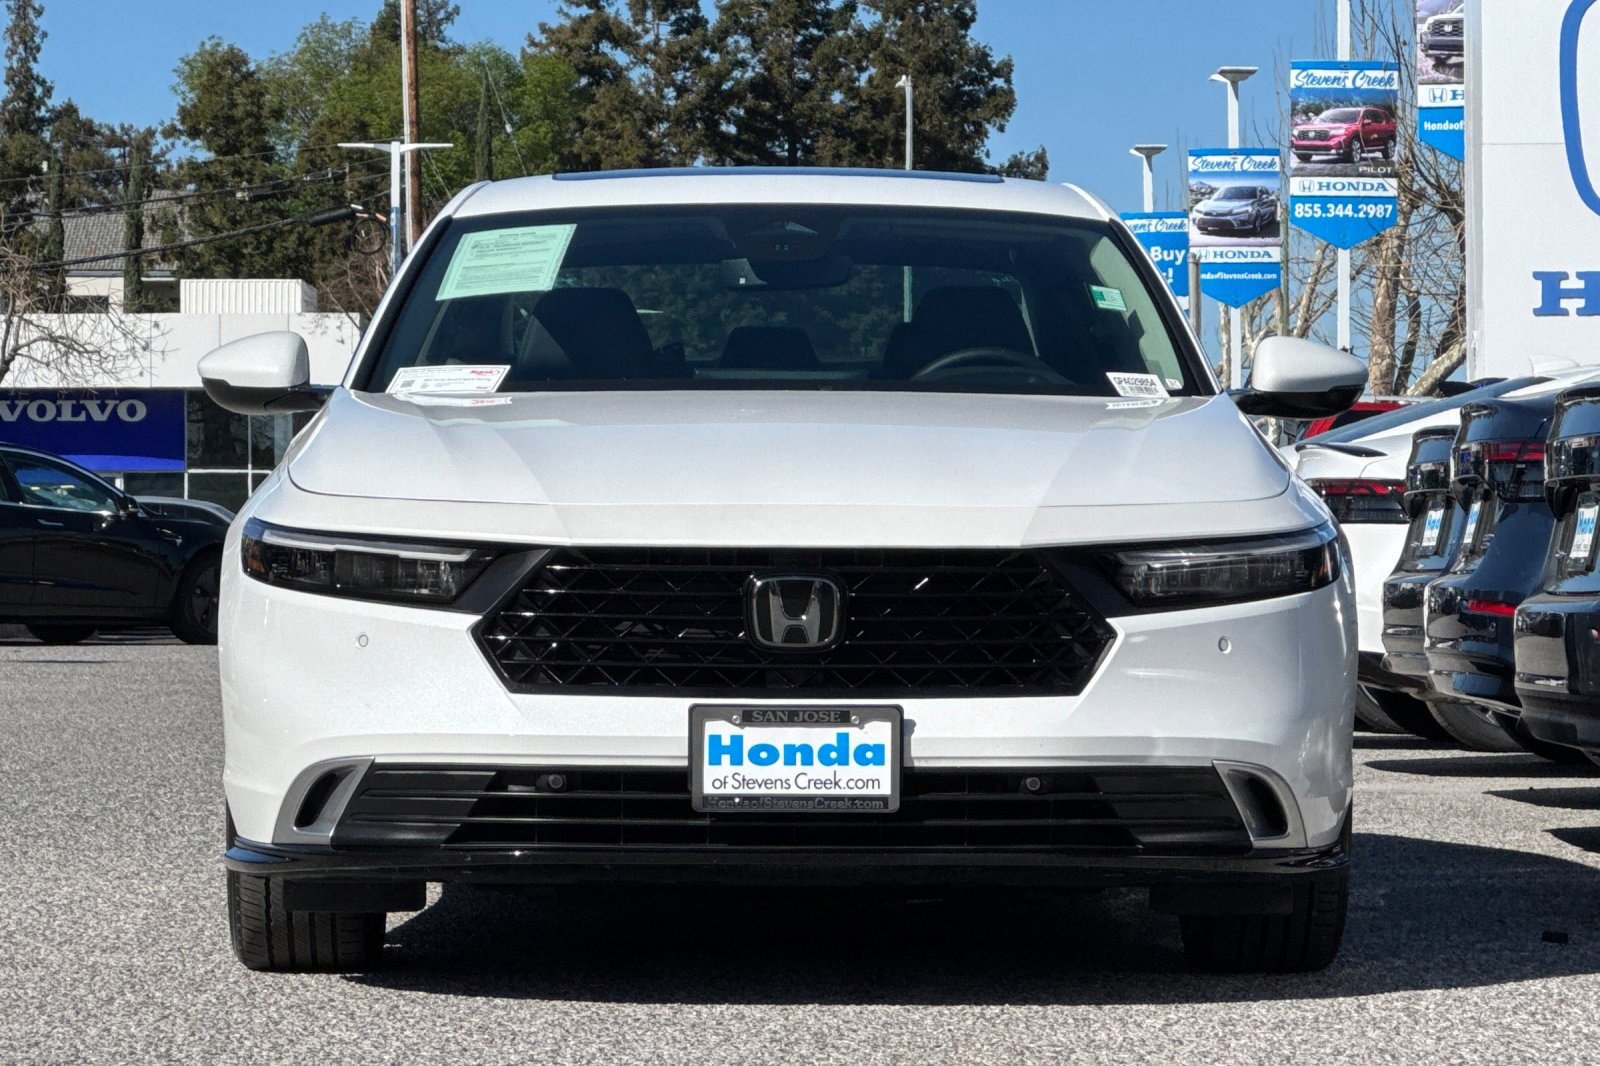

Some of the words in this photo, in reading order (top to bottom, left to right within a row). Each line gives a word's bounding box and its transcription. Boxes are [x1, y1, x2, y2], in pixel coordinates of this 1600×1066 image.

[1294, 70, 1350, 88] Stevens
[1352, 69, 1396, 89] Creek
[1191, 156, 1237, 171] Stevens
[1240, 156, 1277, 172] Creek
[1358, 166, 1393, 174] PILOT
[1317, 181, 1389, 192] HONDA
[1294, 203, 1393, 219] 855.344.2987
[1149, 245, 1186, 266] Buy
[1212, 250, 1273, 260] HONDA
[0, 399, 147, 422] VOLVO
[751, 710, 789, 722] SAN
[794, 710, 841, 723] JOSE
[708, 732, 885, 767] Honda
[711, 774, 729, 790] of
[731, 772, 791, 790] Stevens
[794, 770, 881, 790] Creek.com
